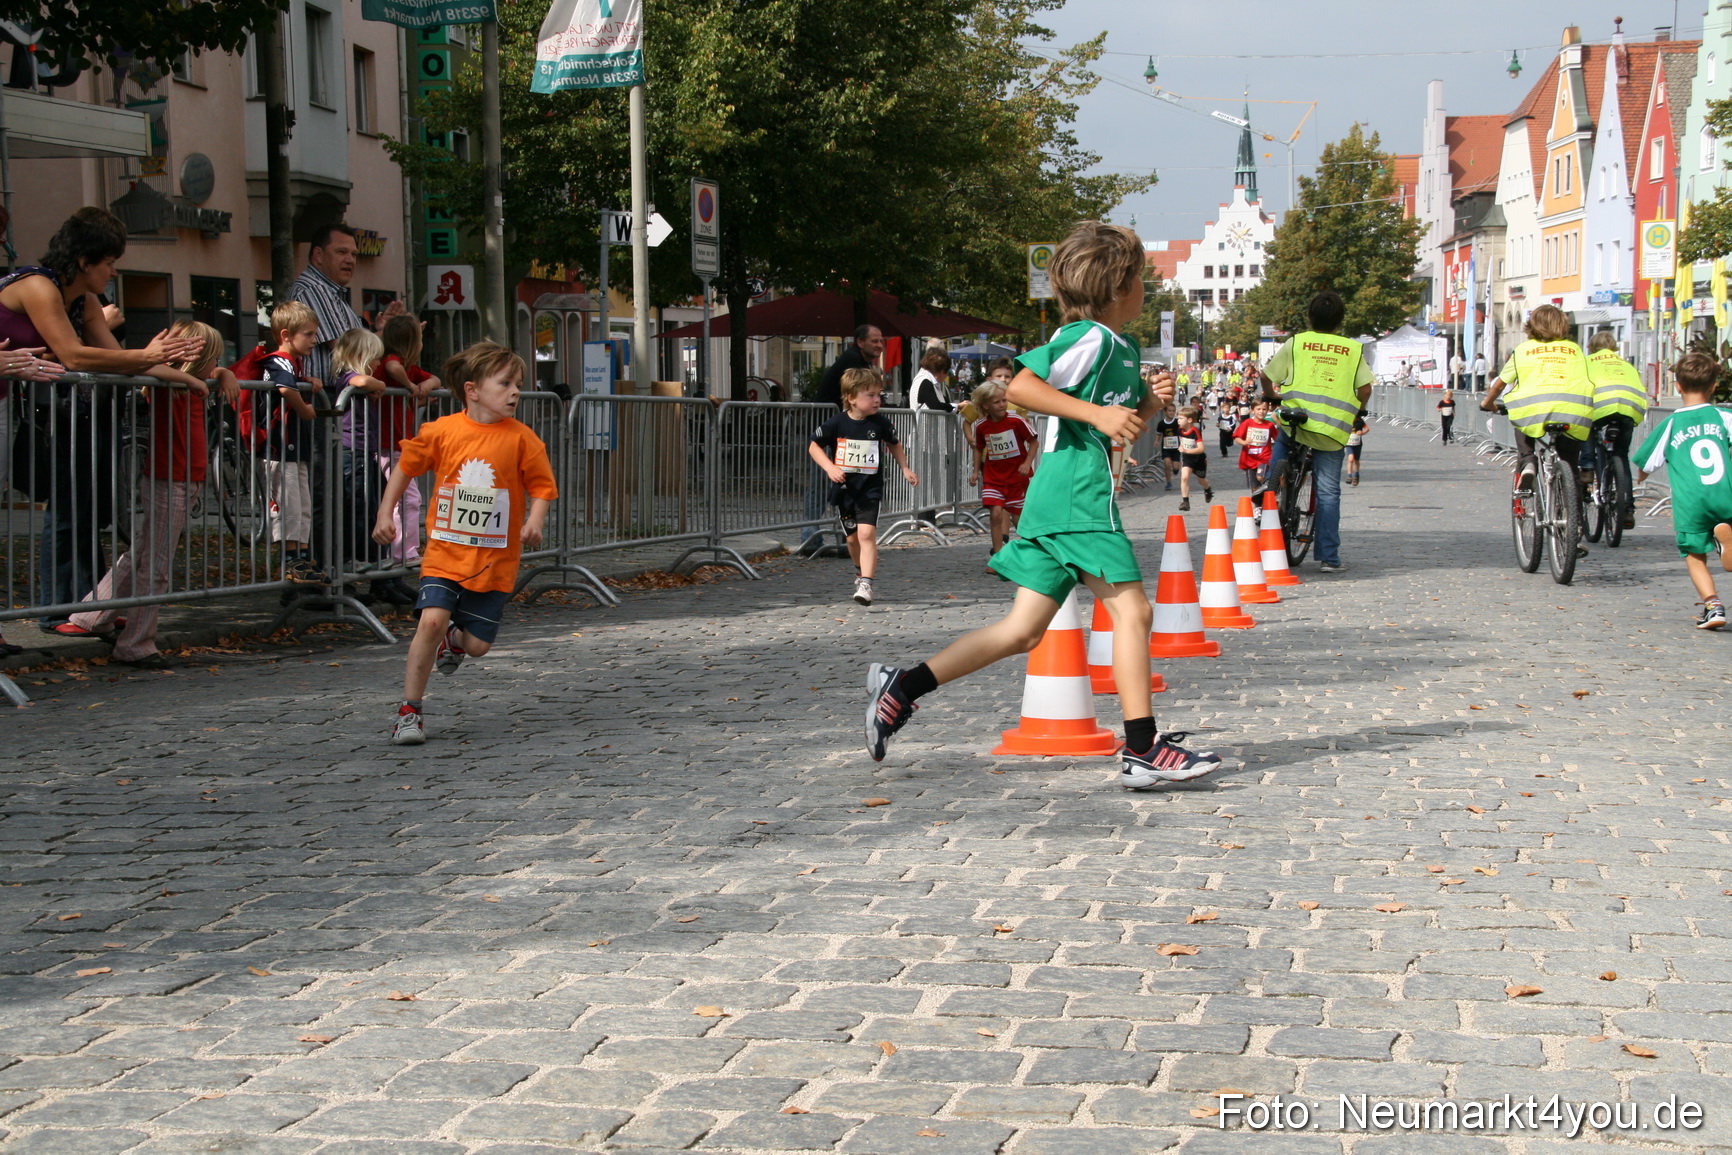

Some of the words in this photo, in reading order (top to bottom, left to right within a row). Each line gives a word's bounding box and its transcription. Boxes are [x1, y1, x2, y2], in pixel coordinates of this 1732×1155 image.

[700, 224, 712, 234] ZONE
[1303, 342, 1350, 356] HELFER
[1526, 345, 1576, 357] HELFER
[848, 442, 861, 450] Mika
[993, 440, 1014, 451] 7031
[848, 453, 875, 464] 7114
[1690, 438, 1725, 485] 9
[458, 489, 493, 504] Vinzenz
[438, 503, 448, 513] K2
[457, 507, 501, 528] 7071
